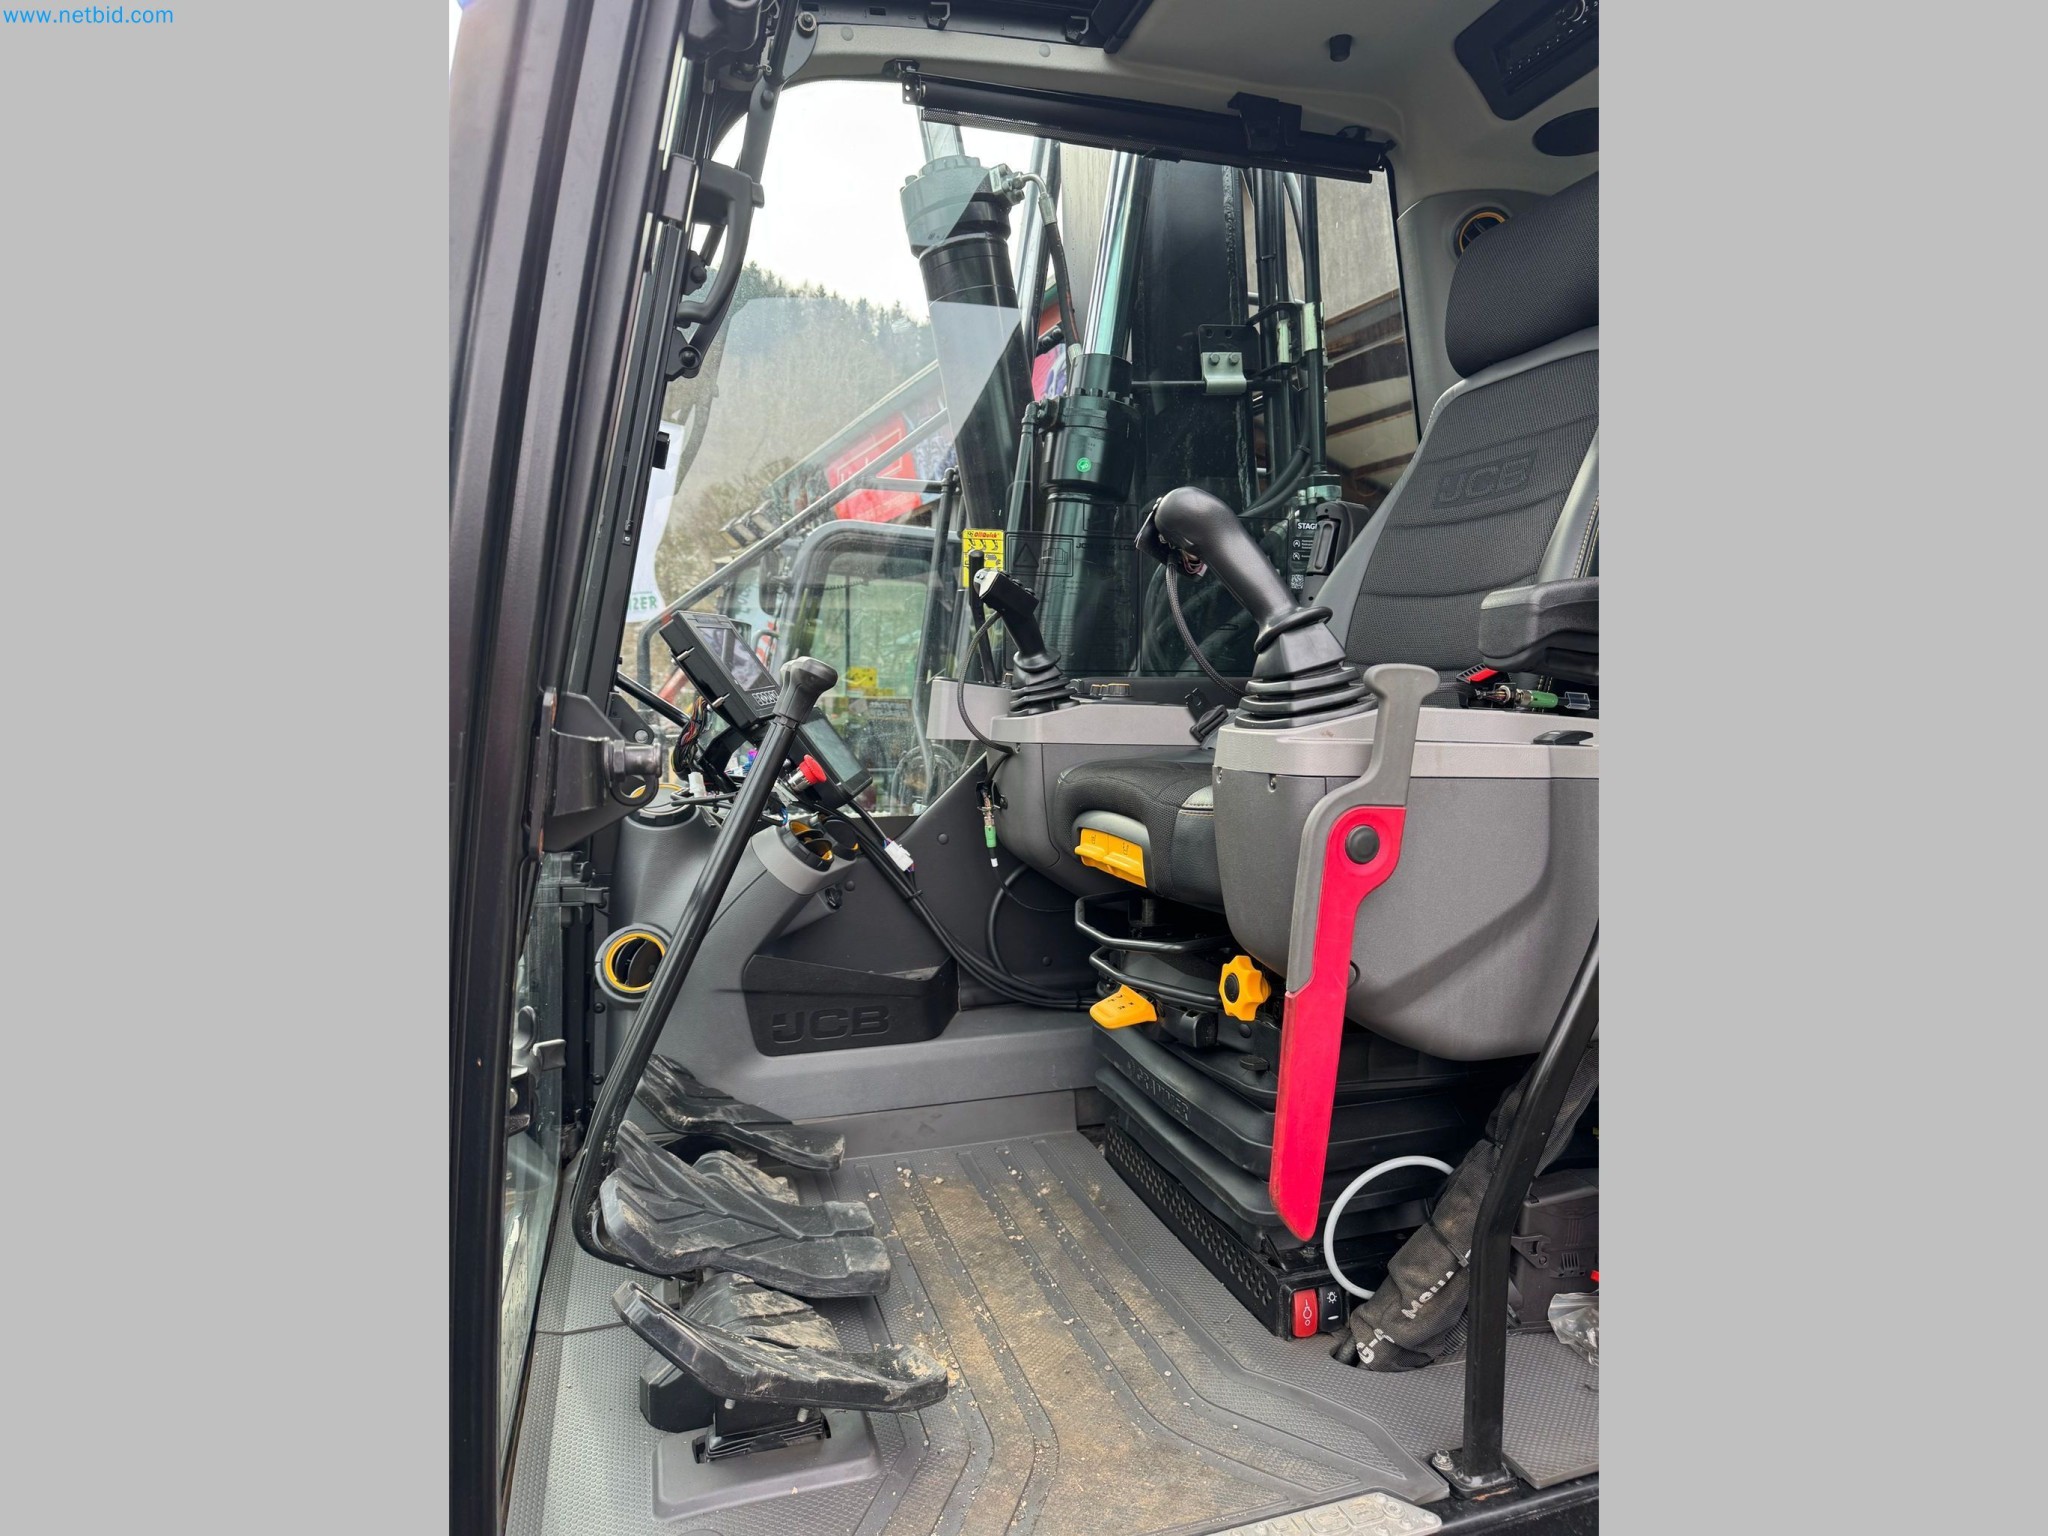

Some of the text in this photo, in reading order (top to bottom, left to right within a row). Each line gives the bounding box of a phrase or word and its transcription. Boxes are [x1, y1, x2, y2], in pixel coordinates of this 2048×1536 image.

[1439, 458, 1530, 500] JCB
[1297, 522, 1318, 530] STAG
[772, 1005, 889, 1043] JCB
